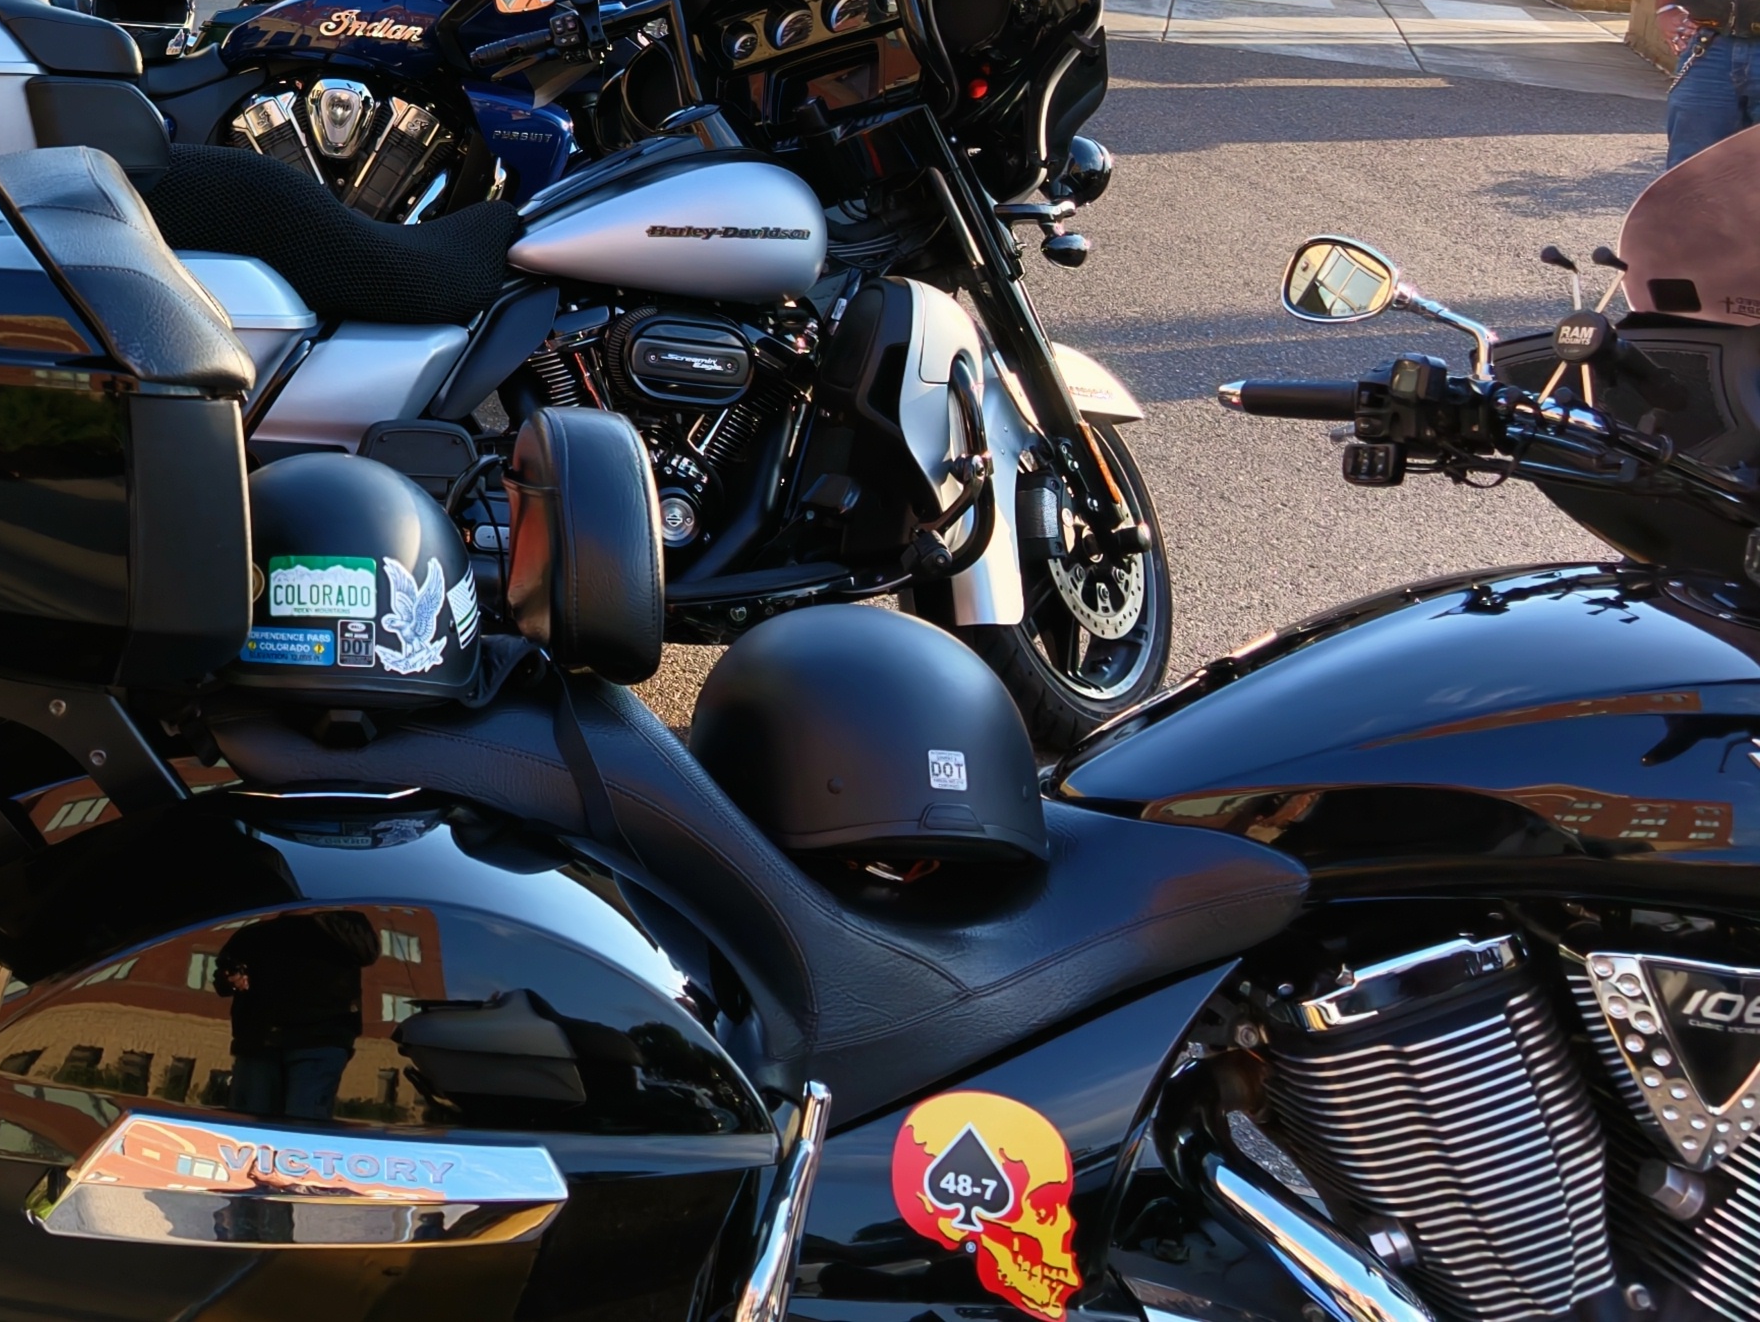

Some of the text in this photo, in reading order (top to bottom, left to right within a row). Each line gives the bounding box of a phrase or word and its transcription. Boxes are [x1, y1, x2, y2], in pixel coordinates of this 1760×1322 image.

[319, 9, 424, 42] Indian
[492, 130, 553, 143] PURSUIT
[645, 225, 811, 240] Harley-Davidson
[1559, 325, 1596, 344] RAM
[273, 584, 371, 607] COLORADO
[248, 631, 305, 642] DEPENDENCE
[259, 641, 311, 653] COLORADO
[341, 639, 371, 656] DOT
[931, 761, 964, 779] DOT
[218, 1144, 454, 1184] VICTORY
[940, 1172, 998, 1200] 48-7
